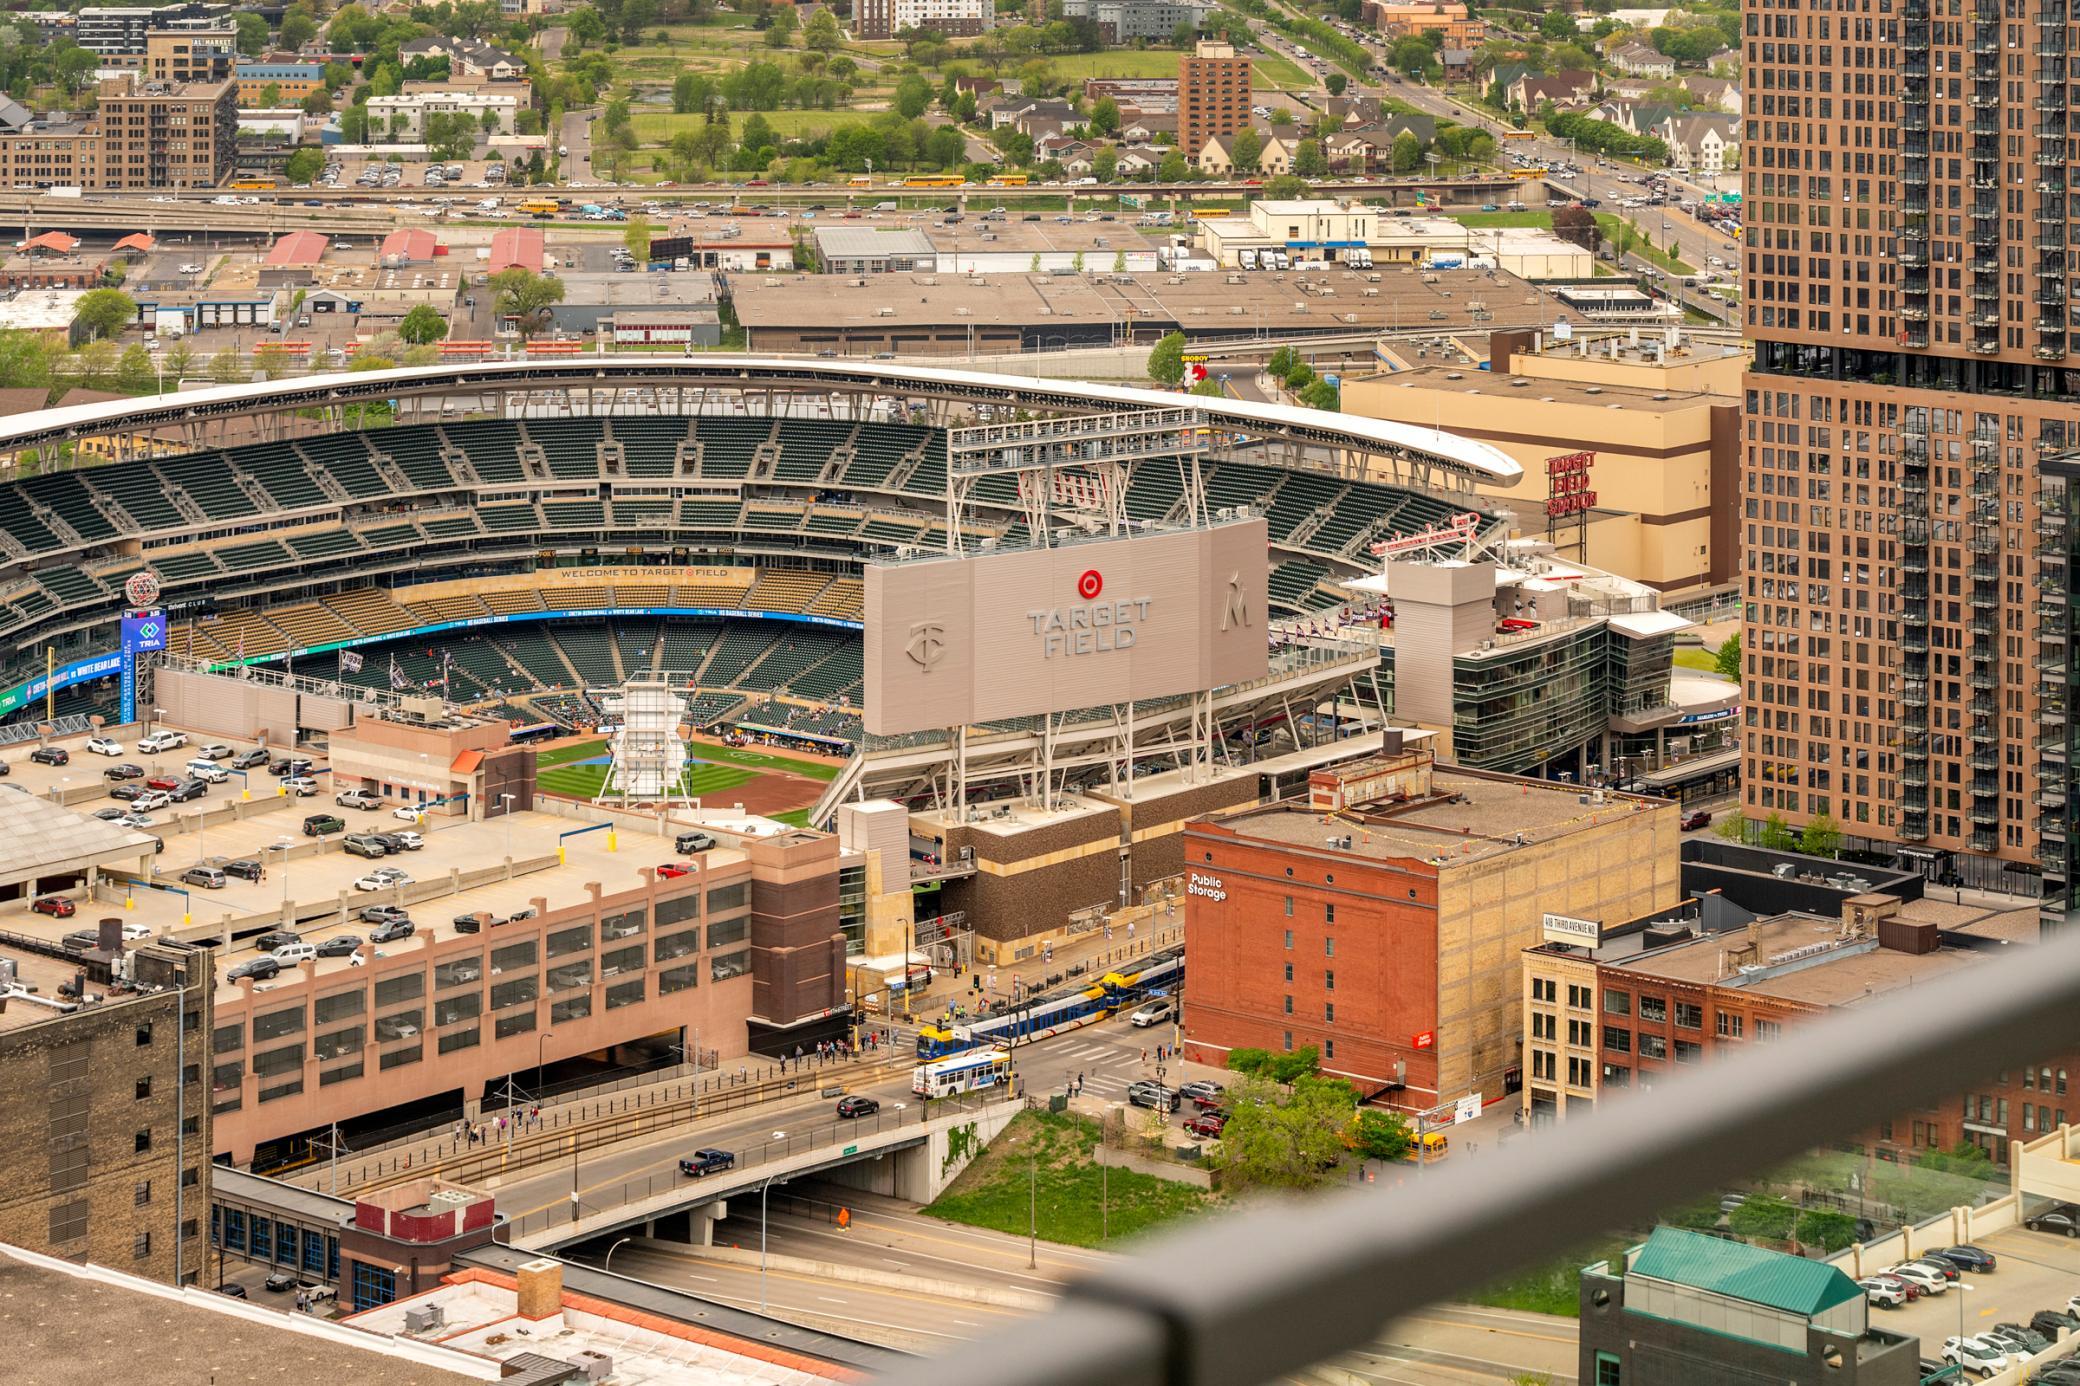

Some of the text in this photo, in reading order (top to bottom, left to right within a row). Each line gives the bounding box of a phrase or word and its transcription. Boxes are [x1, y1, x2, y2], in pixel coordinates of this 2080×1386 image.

[1547, 451, 1596, 476] TARGET
[1554, 474, 1590, 494] FIELD
[1546, 491, 1597, 516] STATION
[561, 569, 619, 578] WELCOME
[641, 568, 685, 576] TARGET
[695, 569, 728, 577] FIELD
[1026, 596, 1152, 635] TARGET
[138, 639, 161, 648] TRIA
[1044, 627, 1137, 658] FIELD
[77, 664, 95, 677] WHITE
[95, 661, 107, 673] BEAR
[107, 657, 121, 669] LAKE
[1191, 872, 1222, 888] Public
[1188, 883, 1227, 902] Storage
[1554, 918, 1569, 931] THIRD
[1568, 920, 1588, 934] AVENUE
